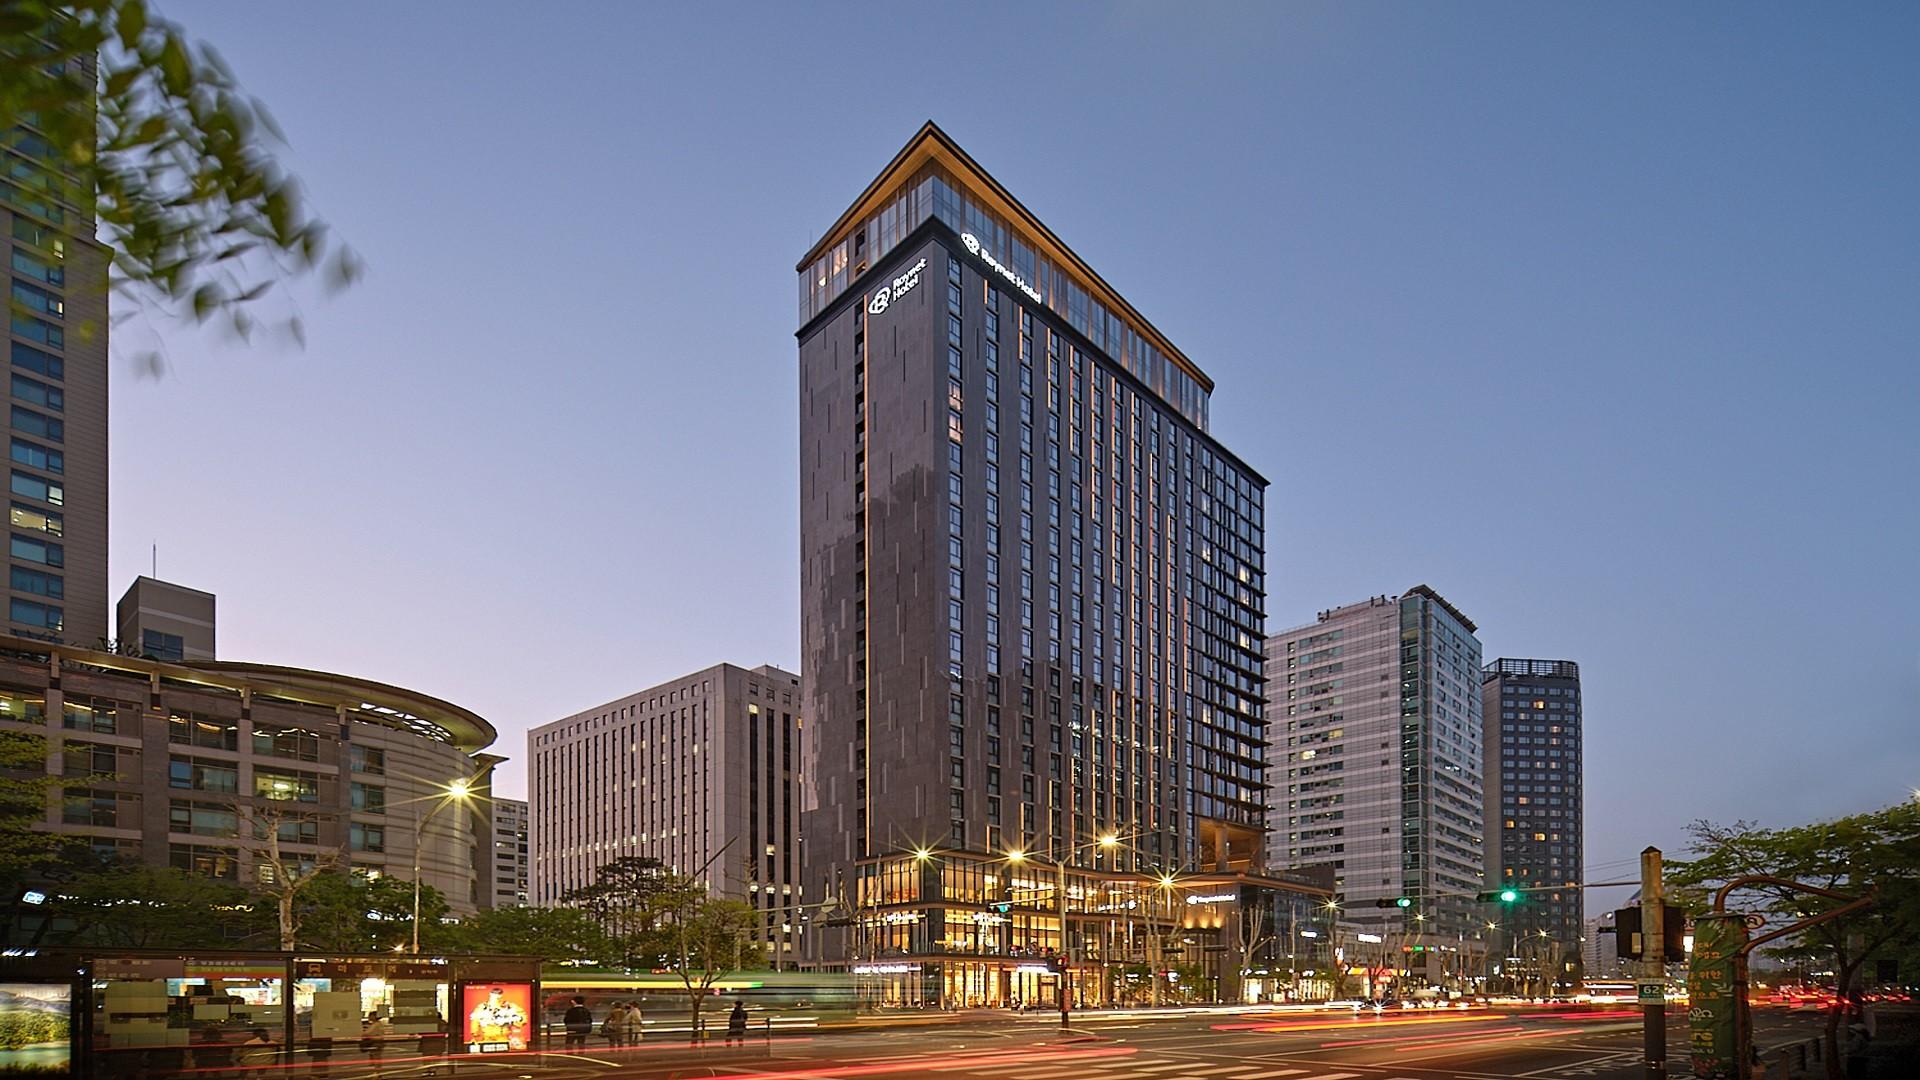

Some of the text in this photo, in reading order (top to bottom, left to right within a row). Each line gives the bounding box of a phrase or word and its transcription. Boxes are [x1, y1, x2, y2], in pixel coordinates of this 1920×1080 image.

[893, 258, 927, 291] Roynet
[893, 274, 919, 302] Hotel
[1017, 276, 1042, 304] Hotel
[1643, 985, 1660, 994] 62
